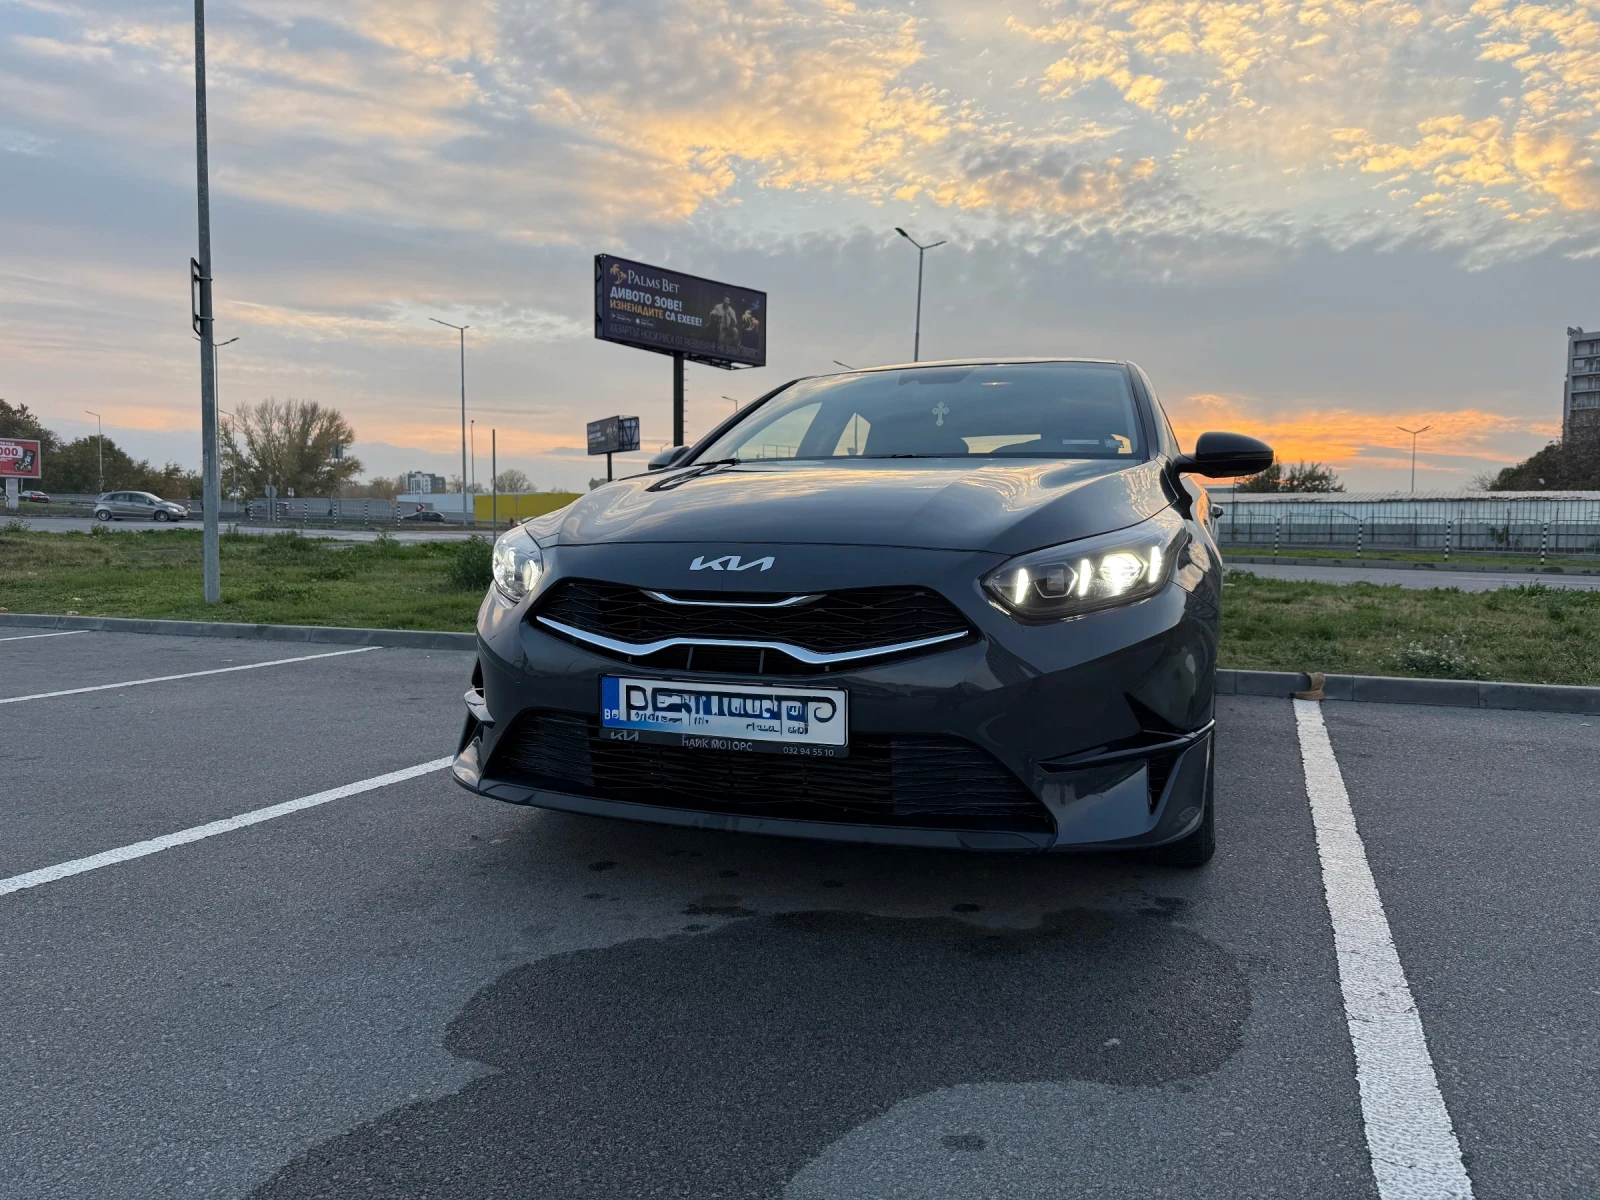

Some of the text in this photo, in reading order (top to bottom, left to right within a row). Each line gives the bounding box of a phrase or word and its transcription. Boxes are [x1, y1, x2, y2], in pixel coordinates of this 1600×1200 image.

[628, 269, 680, 294] PALMS BET
[610, 286, 682, 311] ДИВОТО ЗОВЕ!
[610, 299, 664, 319] ИЗНЕНАДИТЕ
[665, 311, 676, 322] СА
[677, 314, 702, 327] ЕХЕЕЕ!
[689, 555, 776, 572] KIA
[783, 746, 834, 757] 032 94 55 10
